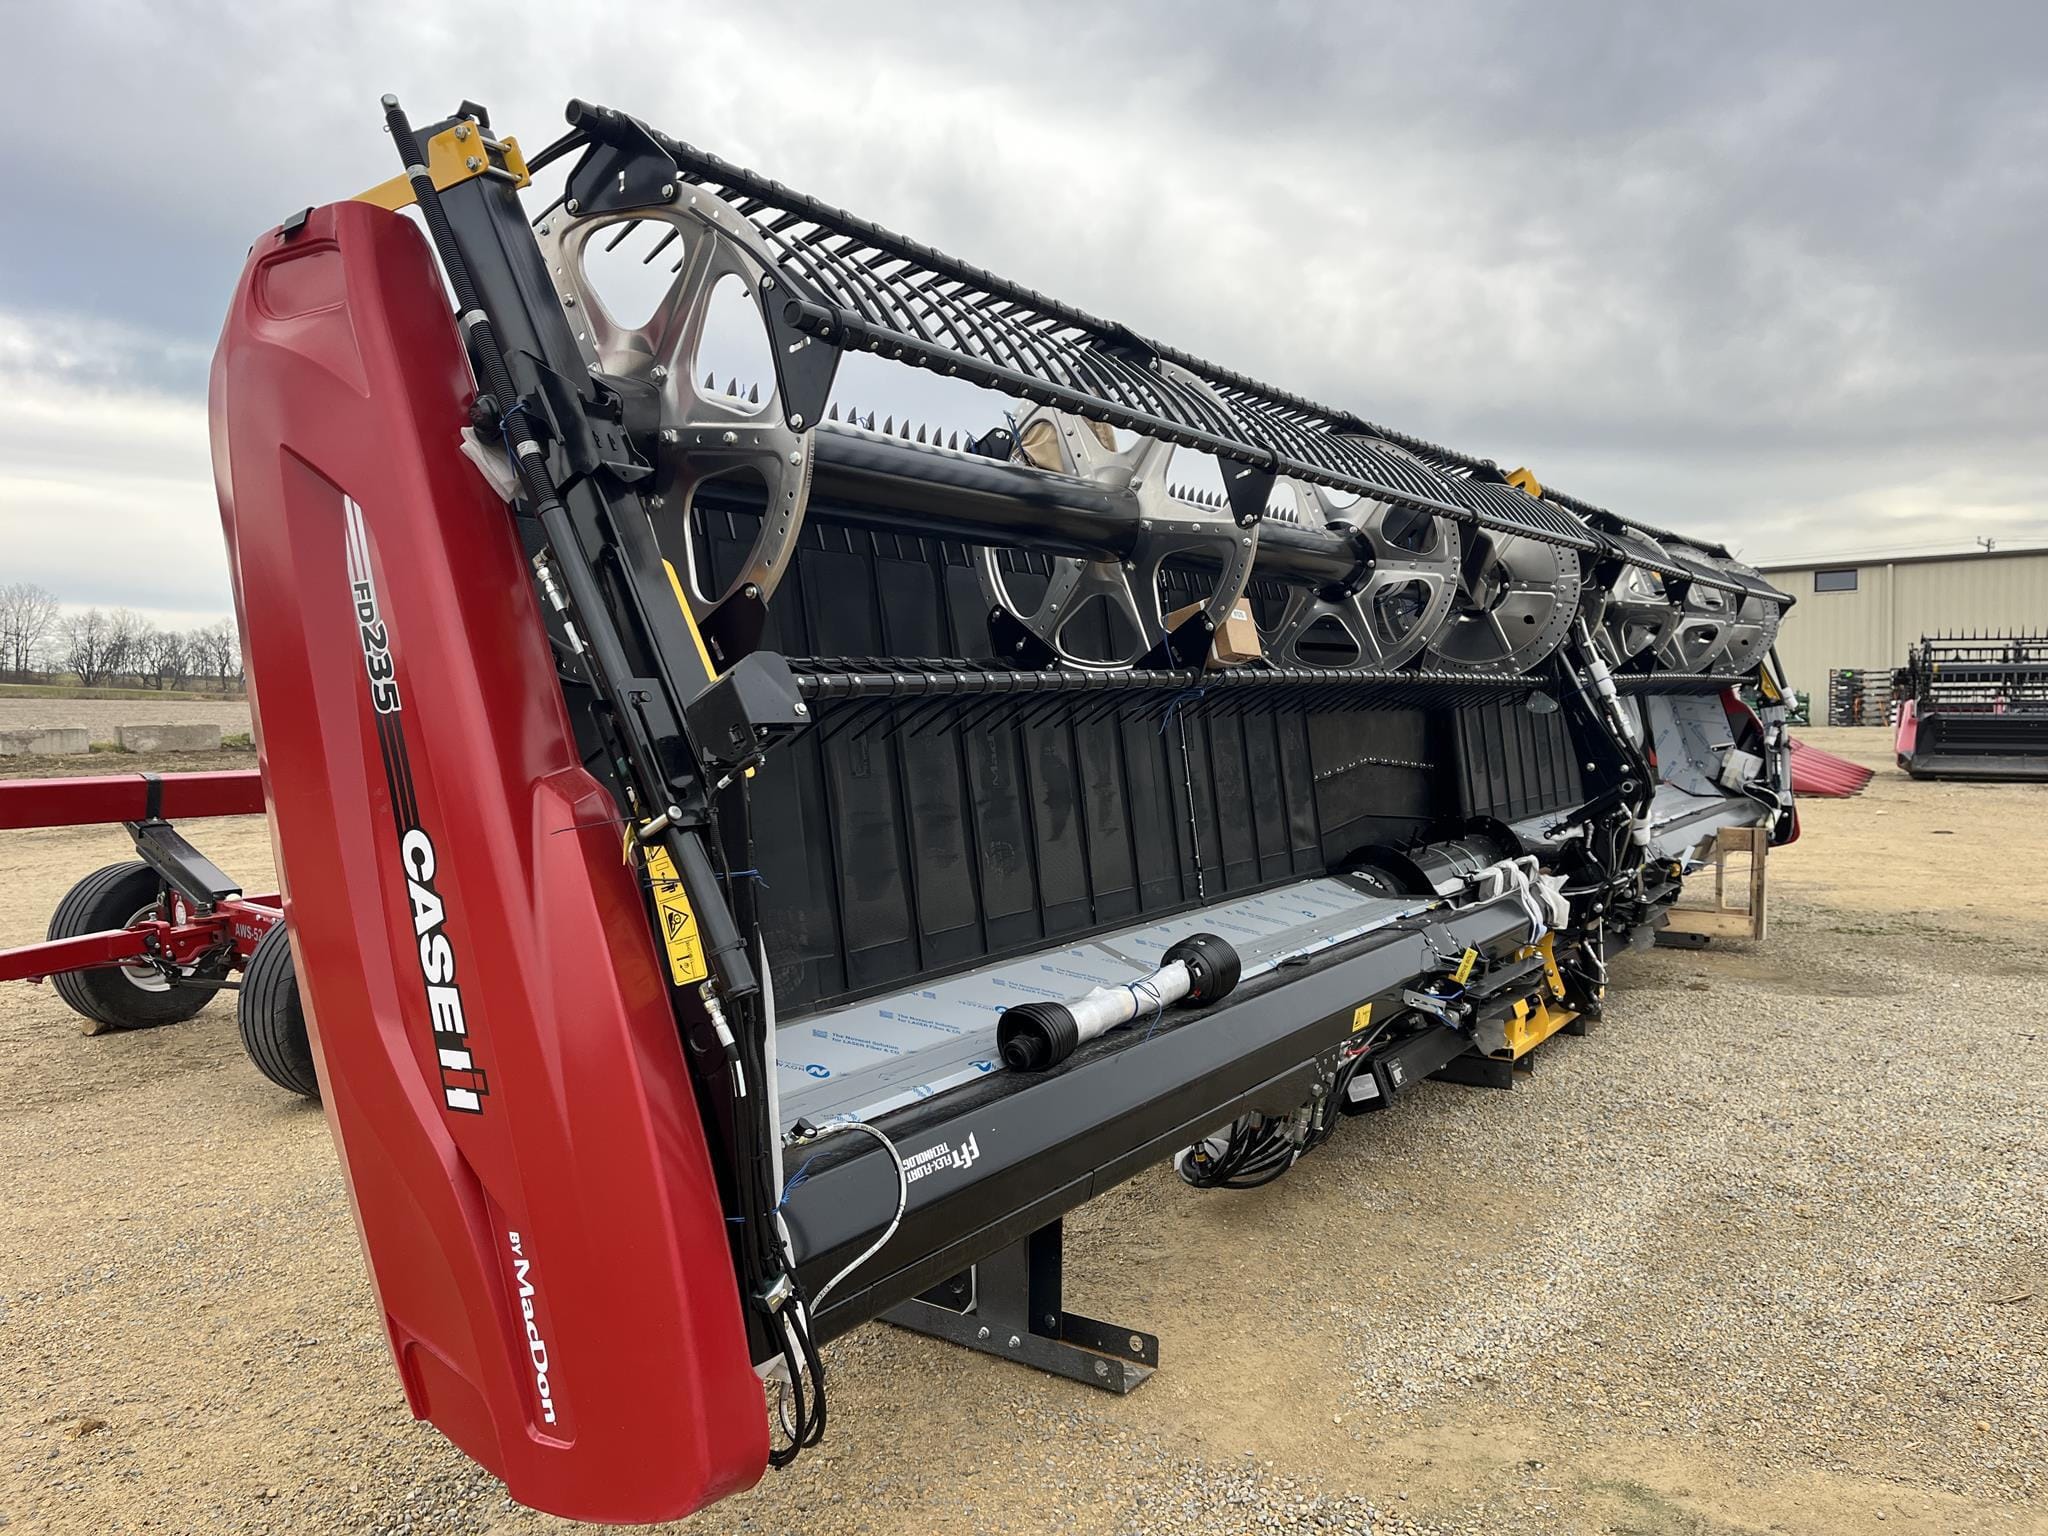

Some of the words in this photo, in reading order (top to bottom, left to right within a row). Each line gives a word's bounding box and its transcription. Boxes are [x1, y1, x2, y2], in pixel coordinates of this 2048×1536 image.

[352, 580, 401, 713] FD235
[401, 828, 467, 1035] CASE
[902, 1141, 950, 1171] TECHNOLOG
[906, 1154, 952, 1184] FLEX-FLOAT
[952, 1131, 980, 1169] FFT
[508, 1232, 523, 1257] BY
[513, 1259, 556, 1425] MacDon
